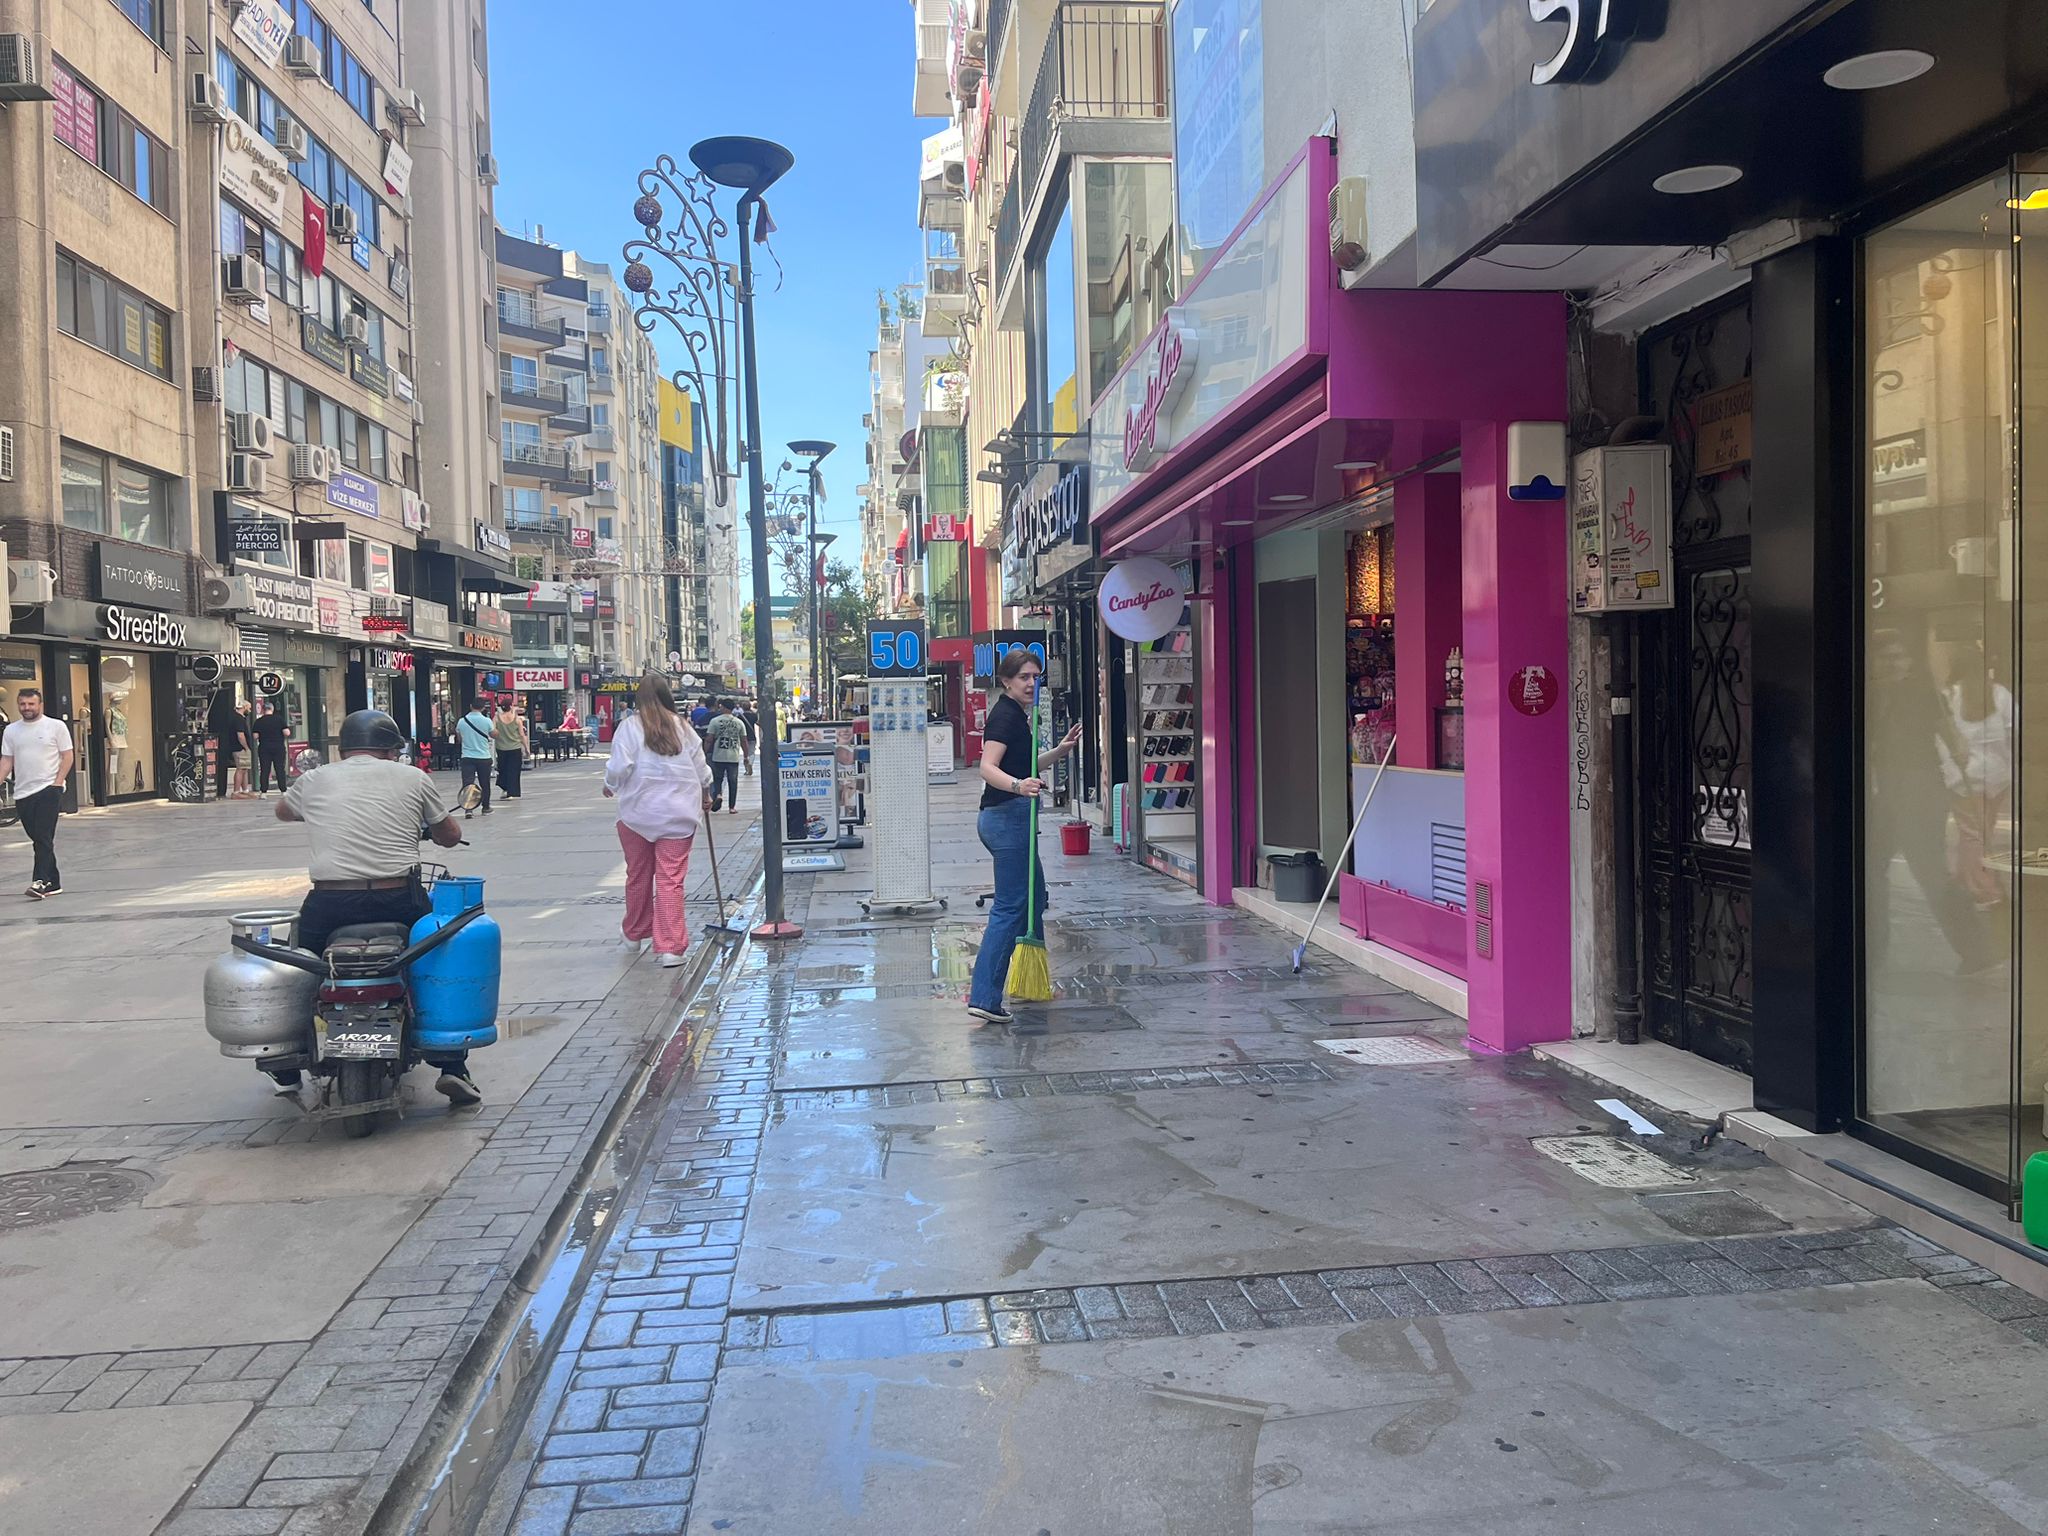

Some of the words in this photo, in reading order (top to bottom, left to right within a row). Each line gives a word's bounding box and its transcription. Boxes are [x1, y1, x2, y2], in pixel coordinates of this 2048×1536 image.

[332, 488, 349, 504] VİZE
[348, 494, 376, 514] MERKEZİ
[235, 533, 278, 542] TATTOO
[235, 542, 280, 550] PIERCING
[104, 563, 143, 586] TATTOO
[157, 578, 181, 593] BULL
[252, 575, 273, 594] LAST
[1108, 580, 1176, 612] CandyZoo
[106, 604, 188, 648] StreetBox
[870, 630, 920, 670] 50
[974, 642, 993, 678] 100
[516, 671, 563, 682] ECZANE
[781, 769, 807, 780] TEKNİK
[807, 768, 832, 778] SERVİS
[786, 788, 803, 797] ALIM
[807, 788, 827, 796] SATIM
[333, 1033, 392, 1043] ARORA
